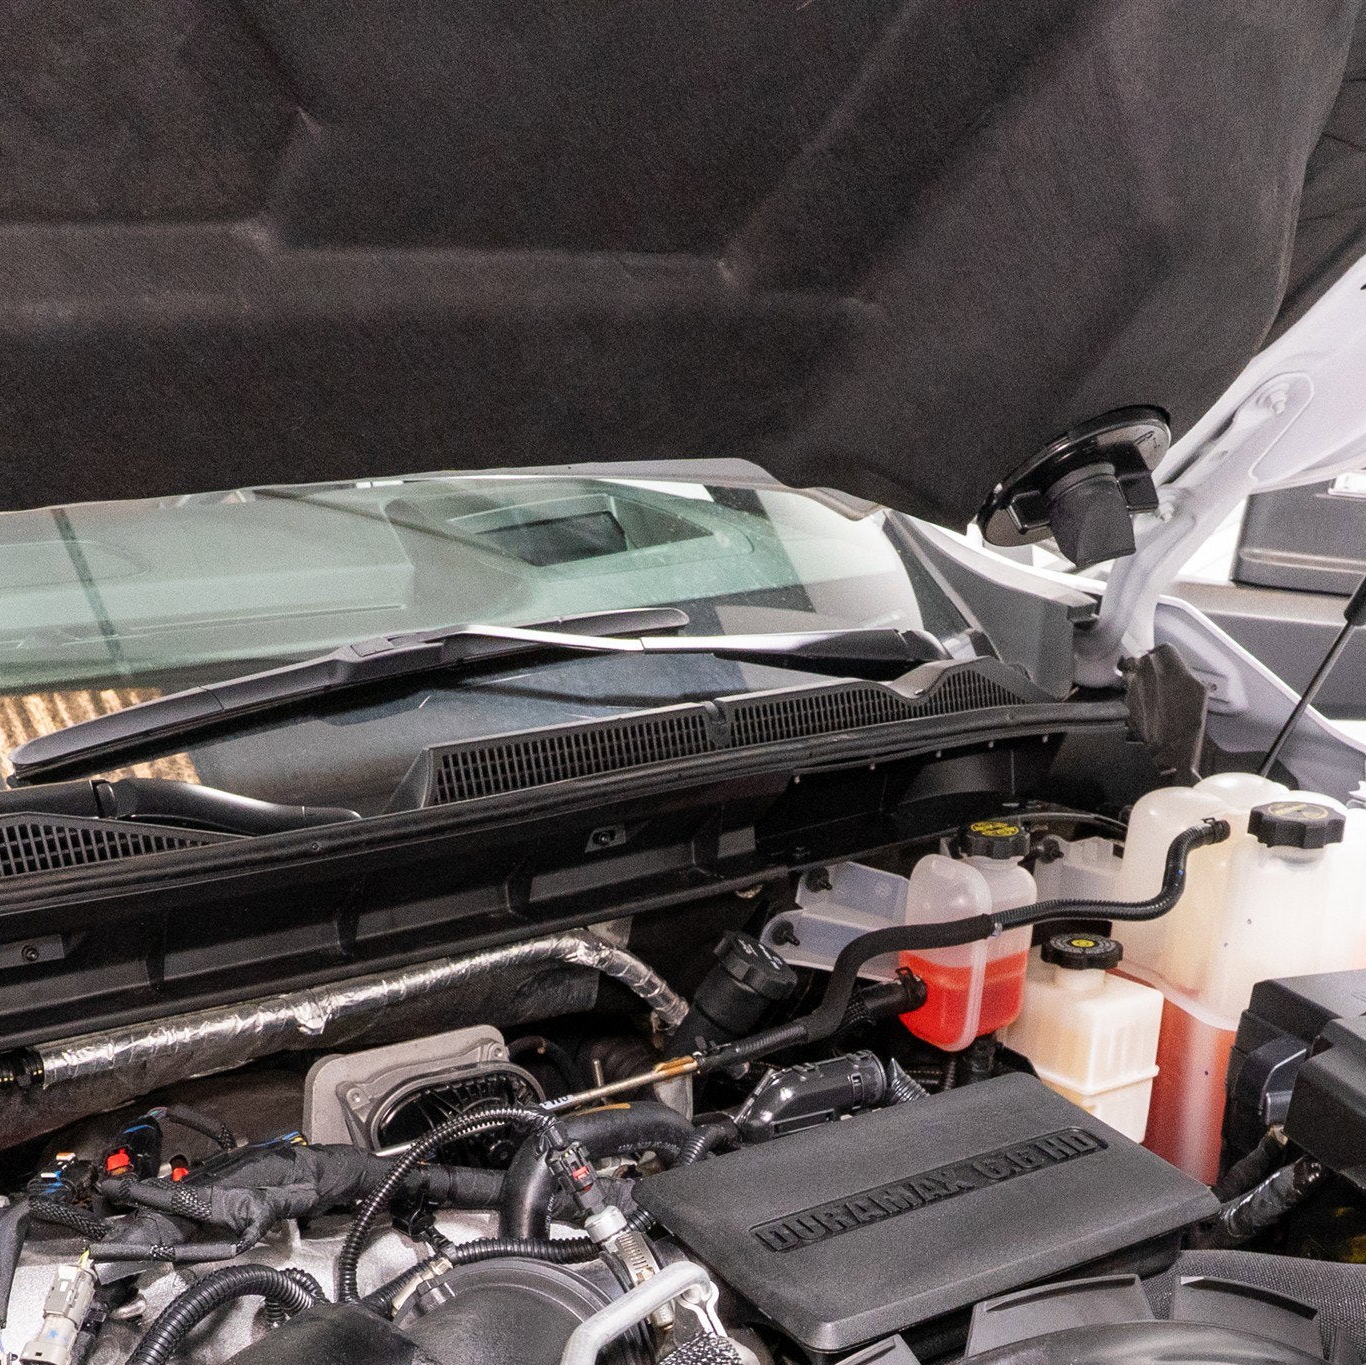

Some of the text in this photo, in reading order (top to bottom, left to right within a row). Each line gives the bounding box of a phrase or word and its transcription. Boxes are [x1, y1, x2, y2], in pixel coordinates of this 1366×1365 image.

[754, 1130, 1104, 1252] DURAMAX 6.6 HD
